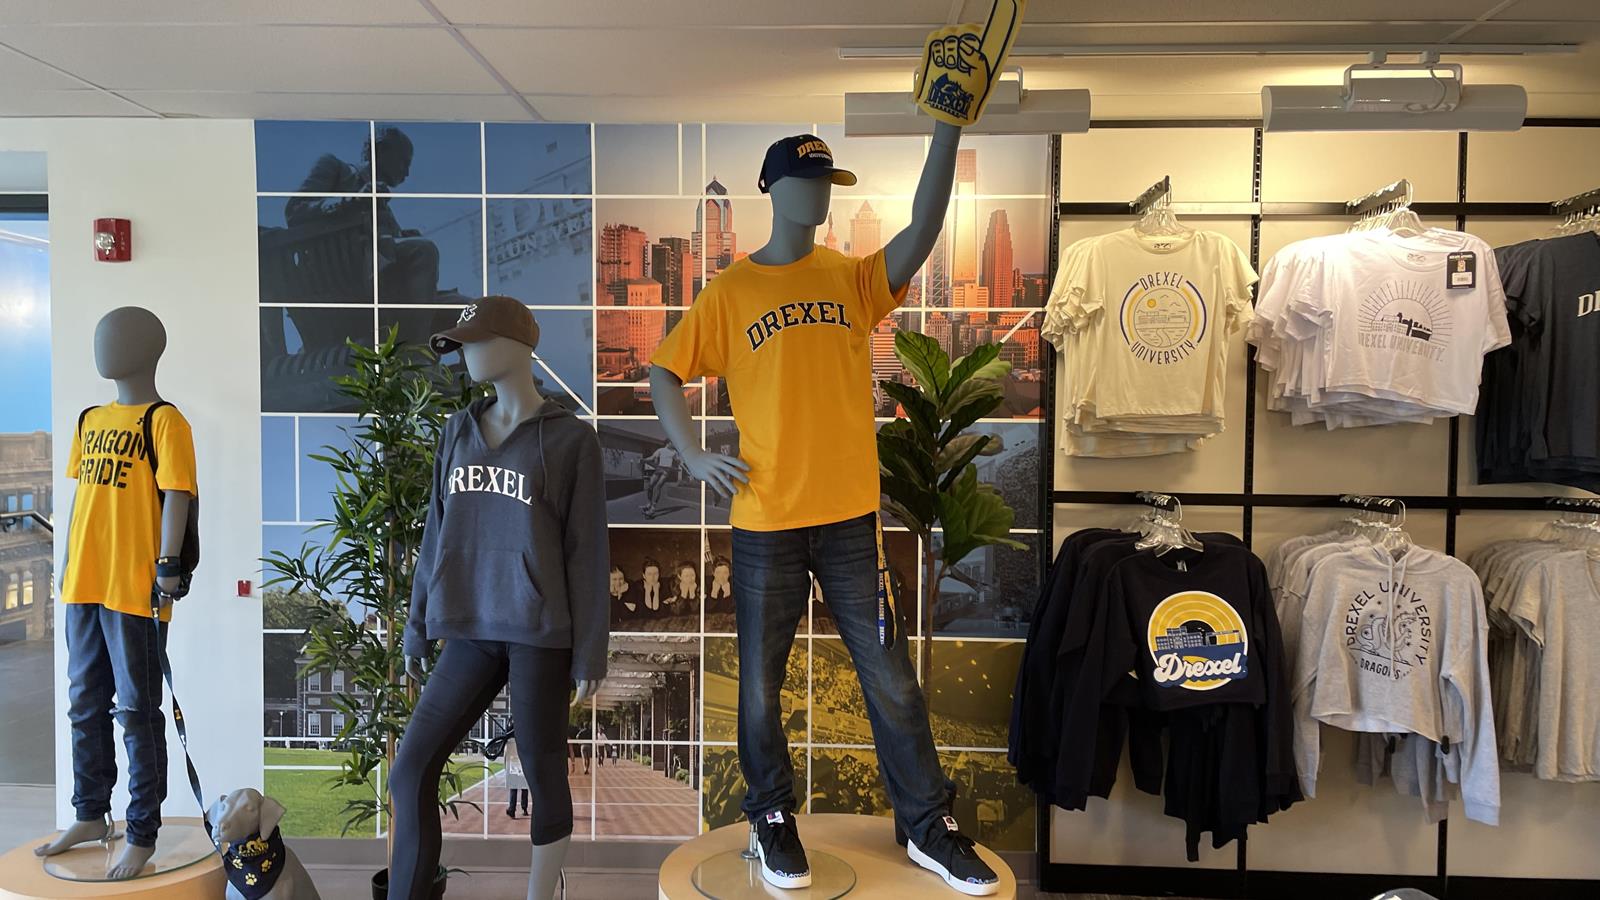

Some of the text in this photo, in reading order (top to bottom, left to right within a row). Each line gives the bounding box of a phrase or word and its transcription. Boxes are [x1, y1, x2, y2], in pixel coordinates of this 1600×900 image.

[1139, 271, 1184, 291] DREXEL
[745, 301, 852, 352] DREXEL
[1130, 339, 1196, 365] UNIVERSITY
[83, 429, 147, 460] RAGON
[448, 465, 533, 506] REXEL
[1345, 581, 1431, 665] DREXEL UNIVERSITY
[1154, 652, 1242, 683] Drexel
[1360, 658, 1401, 680] DRAGOS
